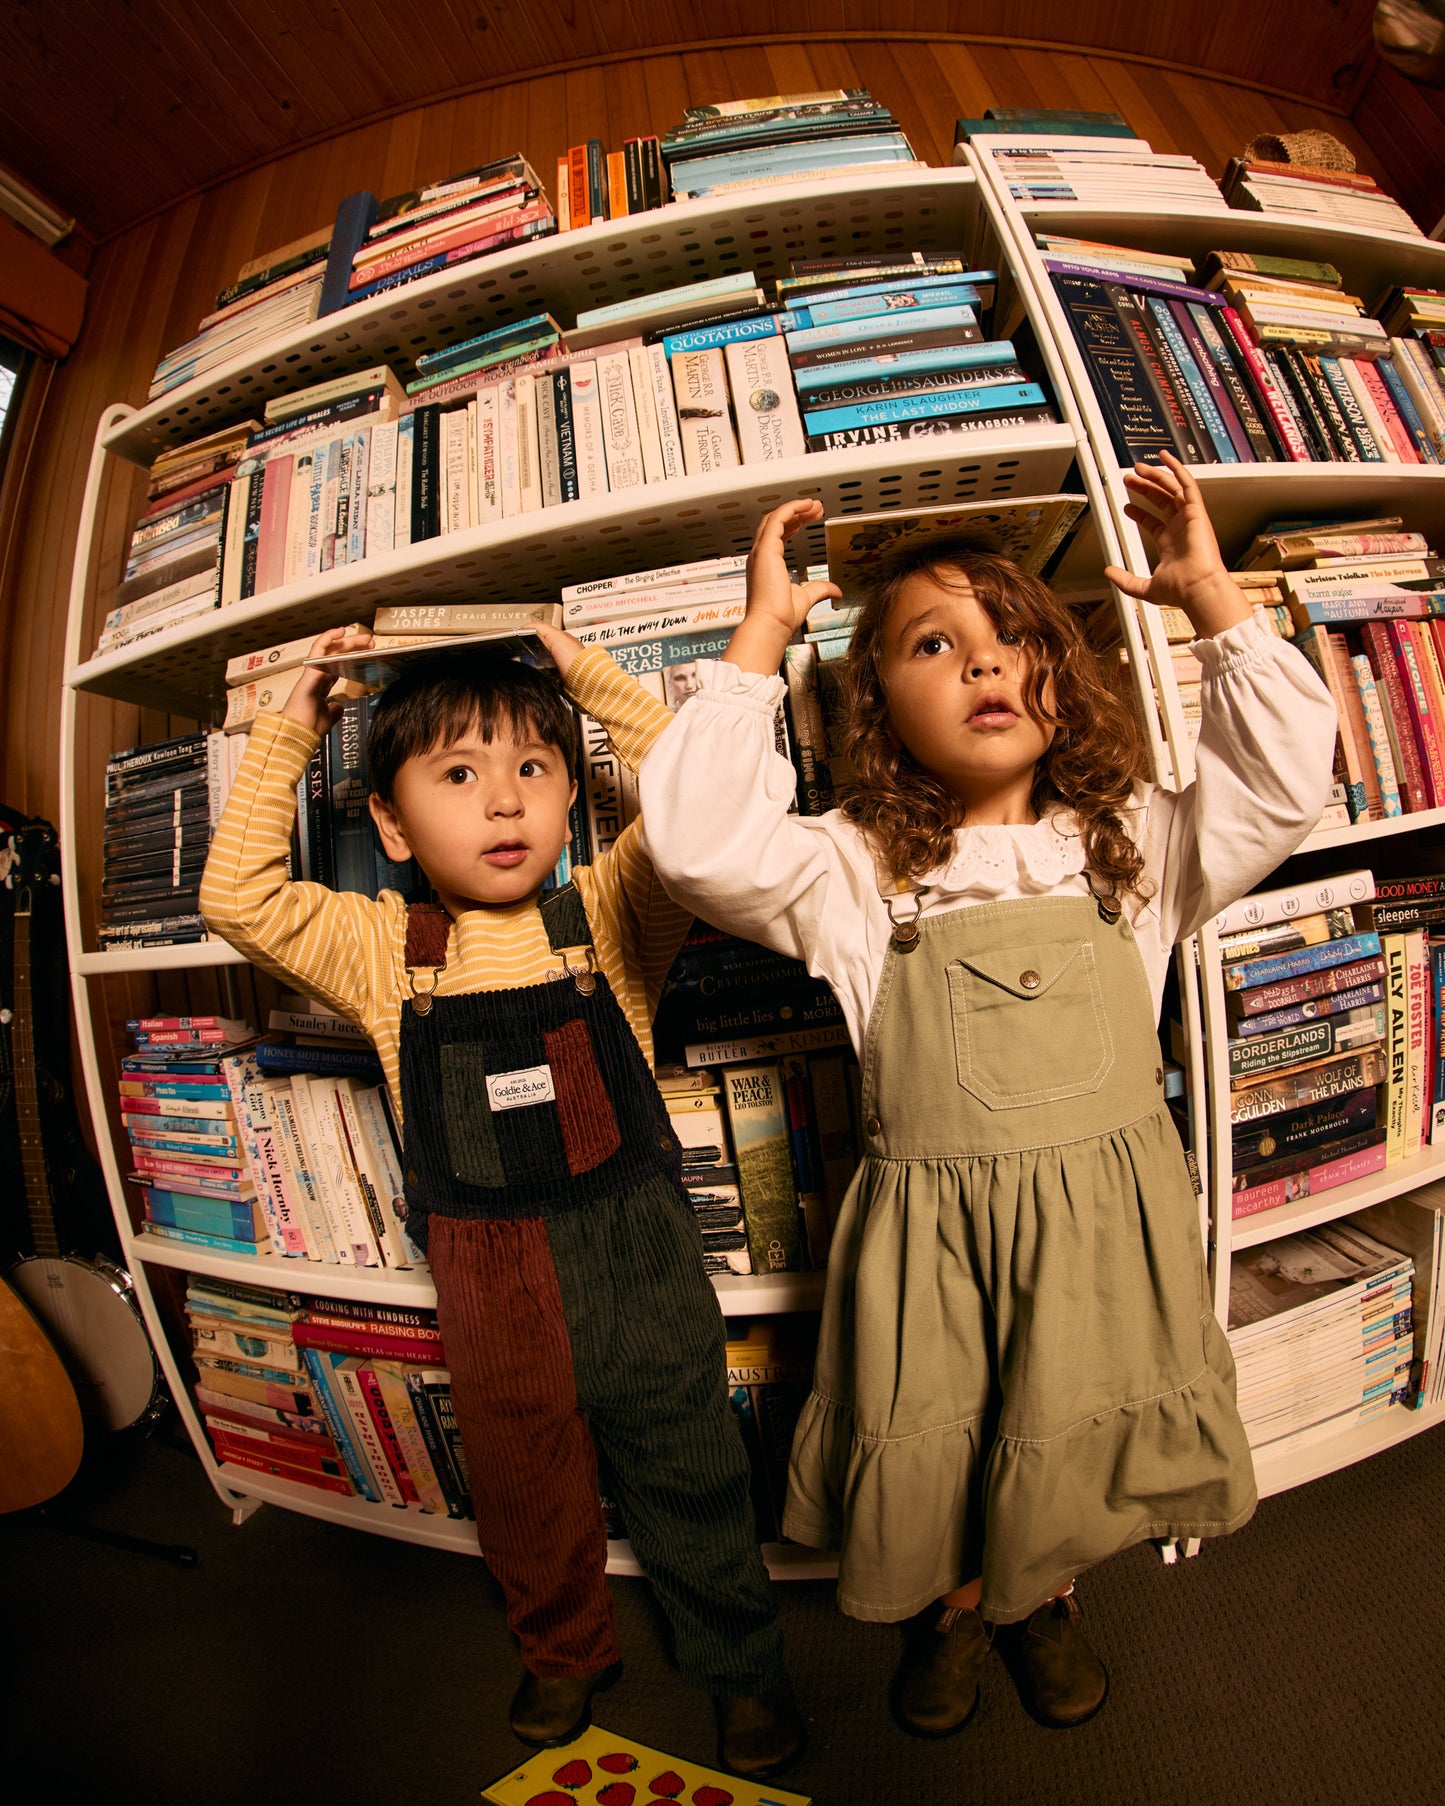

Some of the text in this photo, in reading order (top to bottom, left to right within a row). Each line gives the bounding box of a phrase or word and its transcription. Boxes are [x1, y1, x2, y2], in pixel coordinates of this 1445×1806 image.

[376, 259, 434, 289] DETAILS
[1062, 262, 1120, 278] INTO YOUR ARMS
[670, 320, 774, 351] QUOTATIONS
[1084, 320, 1120, 334] AUSTEN
[522, 348, 596, 373] JAMIE DURIE
[816, 350, 840, 360] WOMEN
[850, 346, 867, 355] LOVE
[1192, 337, 1220, 388] sunbathing
[1198, 313, 1252, 414] HANNAH KENT
[685, 356, 701, 398] MARTIN
[743, 345, 761, 388] MARTIN
[803, 358, 873, 374] MORAL DISORDER
[1130, 319, 1187, 428] ALMOST CHIMPANZEE
[408, 368, 517, 407] THE OUTDOOR ROOM
[818, 368, 1004, 404] GEORGE SAUNDERS
[1329, 363, 1365, 424] PATTERSON
[541, 380, 551, 420] NICK CAVE
[608, 376, 626, 438] Nick Cave
[856, 391, 981, 414] KARIN SLAUGHTER
[861, 400, 981, 423] THE LAST WIDOW
[265, 424, 286, 438] SECRET
[286, 418, 298, 430] LIFE
[298, 416, 307, 425] OF
[307, 408, 331, 421] WHALES
[960, 416, 1026, 432] SKAGBOYS
[421, 410, 431, 466] MARGARET ATWOOD
[560, 420, 574, 467] VIETNAM
[824, 425, 901, 447] IRVINE
[584, 406, 597, 492] MEMOIRS OF GEISHA
[697, 426, 712, 473] THRONES
[711, 435, 722, 461] GAME
[665, 441, 679, 479] Century
[351, 469, 363, 530] LAURA FRIDAY
[576, 568, 682, 594] CHOPPER The Singing Defective
[1305, 574, 1337, 584] Christos
[1337, 572, 1369, 582] Tsiolkas
[1369, 570, 1382, 578] The
[1393, 568, 1423, 576] Between
[586, 594, 659, 611] DAVID MITCHELL
[1306, 588, 1353, 599] burnt sugar
[1322, 600, 1366, 609] MARY ANN
[391, 607, 446, 619] JASPER
[491, 612, 528, 620] SILVEY
[1329, 608, 1369, 619] AUTUMN
[1373, 602, 1404, 615] Maupin
[393, 618, 441, 628] JONES
[600, 611, 719, 641] ALL THE WAY DOWN JOHN
[668, 637, 731, 659] barrac
[342, 706, 360, 771] LARSSON
[106, 762, 121, 774] PAUL
[122, 753, 152, 769] THEROUX
[153, 748, 178, 760] Kowloon
[178, 743, 193, 754] Tong
[211, 749, 219, 771] SPOT
[311, 770, 323, 800] SEX
[212, 786, 221, 823] BOTHER
[1375, 881, 1438, 898] LOOD MONEY
[1378, 908, 1420, 923] sleepers
[1226, 943, 1260, 960] MOVIES
[1250, 957, 1311, 978] CHARLAINE HARRIS
[1336, 963, 1376, 981] CHARLAINE
[1344, 974, 1373, 988] HARRIS
[1340, 997, 1366, 1011] HARRIS
[1409, 963, 1422, 1050] ZOE FOSTER
[142, 1020, 163, 1028] Italian
[288, 1015, 328, 1033] Stanley
[696, 1010, 774, 1033] big little lies
[1390, 951, 1405, 1085] LILY ALLEN
[151, 1033, 178, 1042] Spanish
[1232, 1028, 1327, 1062] BORDERLANDS
[700, 1046, 748, 1063] BUTLER
[1241, 1043, 1320, 1069] Riding the Slipstream
[730, 1074, 770, 1091] WAR &
[1314, 1065, 1357, 1087] WOLF OF
[495, 1082, 546, 1097] Goldie & Ace
[506, 1093, 536, 1101] AUSTRALIA
[733, 1087, 773, 1103] PEACE
[1236, 1088, 1273, 1109] CONN
[1310, 1076, 1364, 1101] THE PLAINS
[249, 1092, 259, 1112] Girl
[256, 1092, 267, 1120] Funny
[734, 1099, 774, 1111] LEO TOLSTOY
[1231, 1098, 1286, 1123] GGULDEN
[1286, 1118, 1350, 1142] FRANK MOORHOUSE
[1291, 1110, 1345, 1133] Dark Palace
[261, 1137, 291, 1224] Nick Hornby
[1235, 1194, 1281, 1216] mccarthy
[1236, 1183, 1279, 1204] maureen
[769, 1260, 787, 1271] Pan
[315, 1300, 420, 1326] COOKING WITH KINDNESS
[312, 1316, 331, 1325] STEVE
[370, 1323, 415, 1338] RAISING
[362, 1346, 432, 1361] ATLAS HEART
[369, 1387, 393, 1430] GOOD
